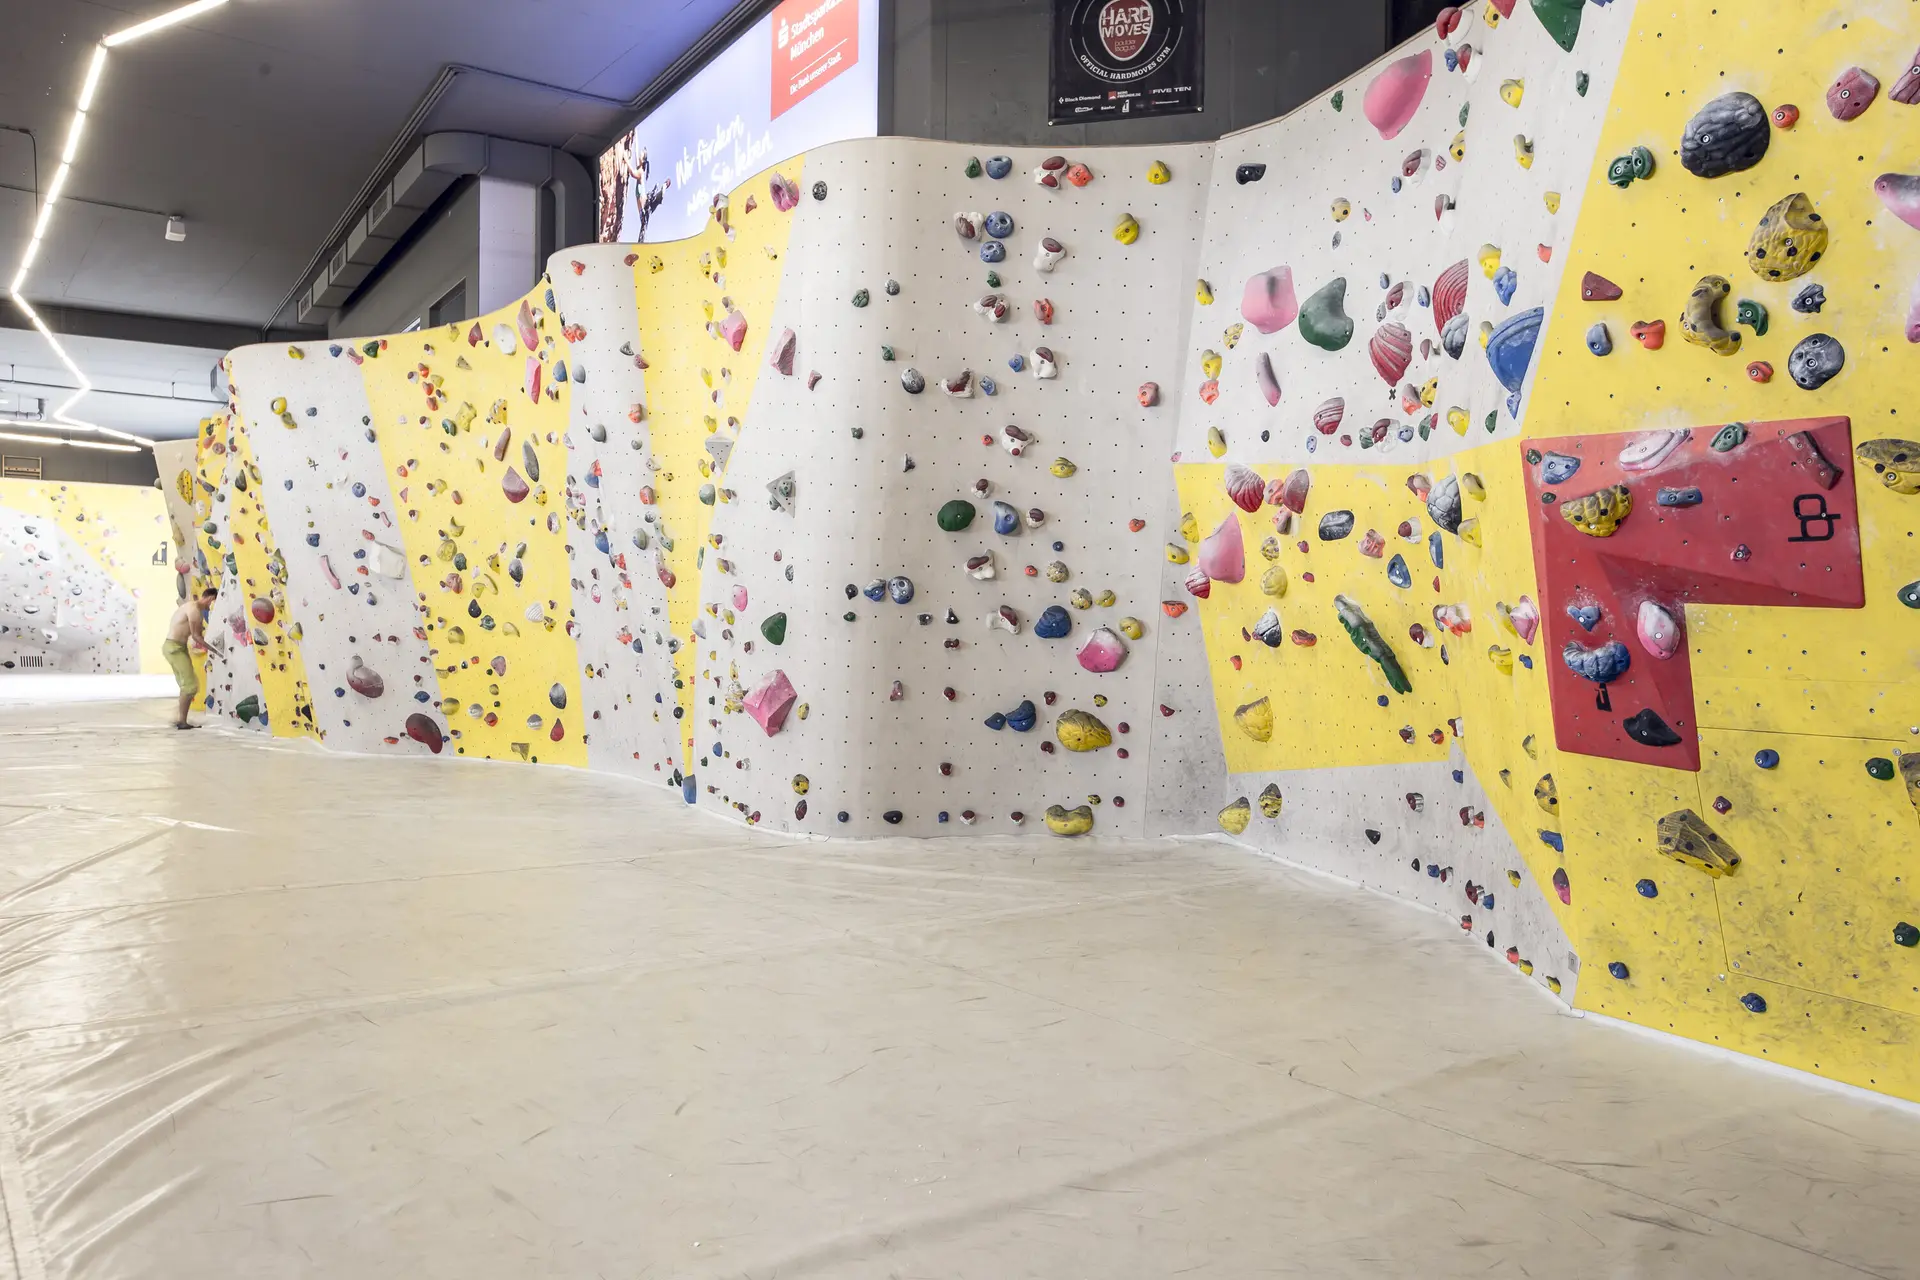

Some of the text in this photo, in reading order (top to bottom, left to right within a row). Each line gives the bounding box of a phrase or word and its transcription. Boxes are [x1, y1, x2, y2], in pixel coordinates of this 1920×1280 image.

[1102, 6, 1151, 25] HARD
[1102, 22, 1150, 38] MOVES
[1080, 46, 1171, 80] OFFICIAL HARDMOVES GYM
